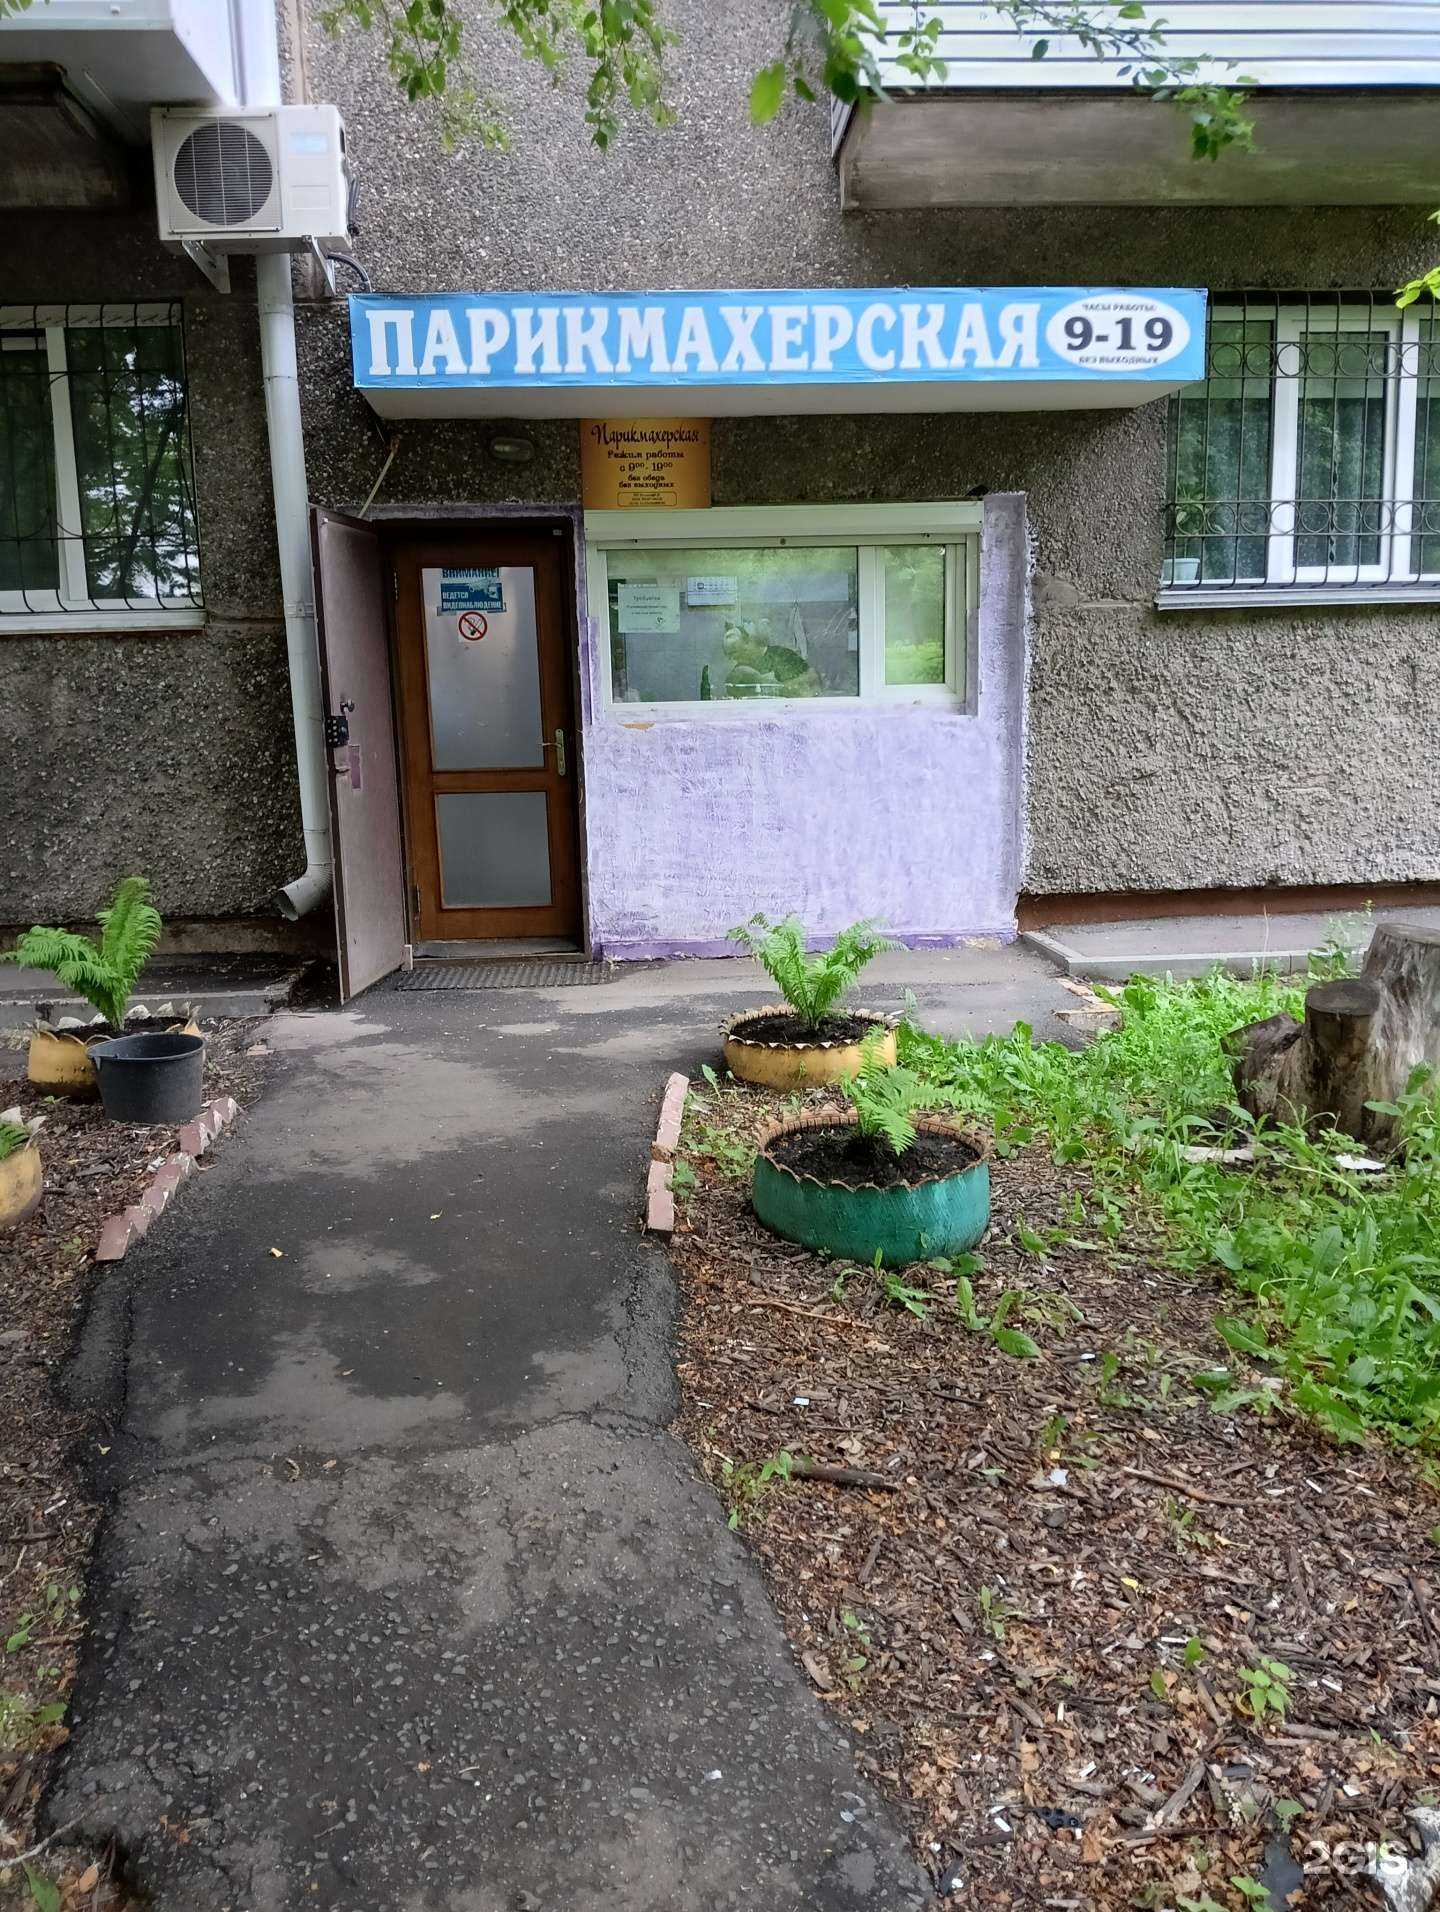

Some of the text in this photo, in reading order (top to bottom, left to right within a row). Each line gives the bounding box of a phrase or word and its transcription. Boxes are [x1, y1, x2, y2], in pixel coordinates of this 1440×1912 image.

[365, 303, 1041, 377] ПАРИКМАХЕРСКАЯ
[1064, 316, 1173, 351] 9-19
[591, 422, 701, 450] Парикмахерская
[607, 449, 684, 460] Режим работы
[634, 482, 674, 490] выходных
[643, 474, 665, 482] обеда
